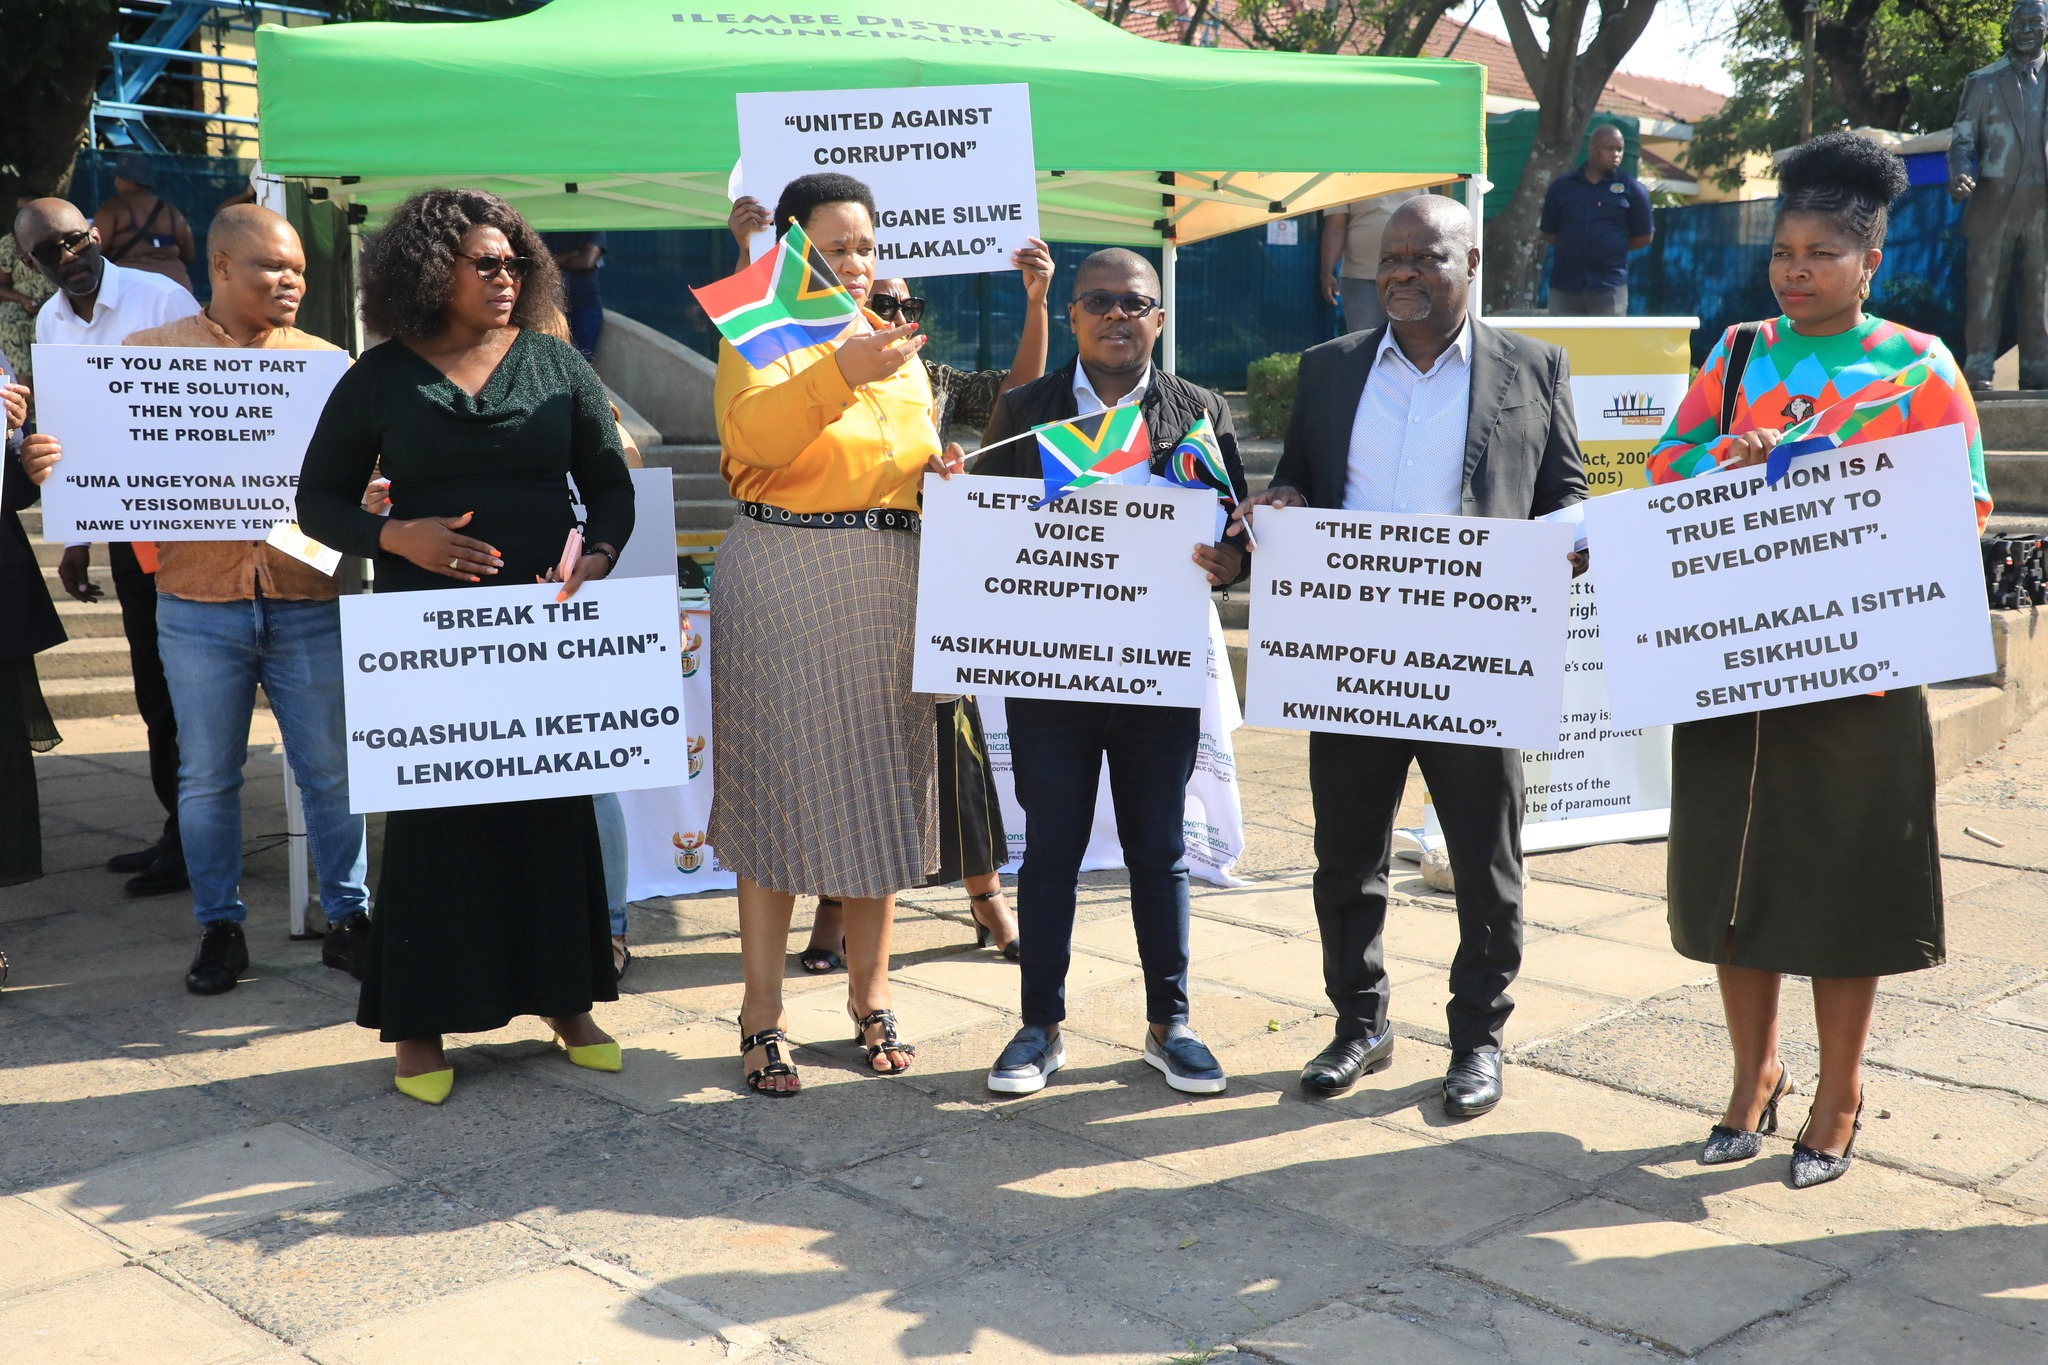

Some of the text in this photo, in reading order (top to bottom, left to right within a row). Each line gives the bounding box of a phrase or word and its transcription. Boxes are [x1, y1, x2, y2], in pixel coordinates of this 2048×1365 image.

[672, 13, 1056, 42] ILEMBE DISTRICT
[726, 28, 1022, 48] MUNICIPALITY
[785, 108, 992, 132] “UNITED AGAINST
[814, 141, 976, 165] CORRUPTION”
[953, 203, 1022, 224] SILWE
[875, 237, 1002, 260] HLAKALO”.
[87, 357, 306, 372] “IF YOU ARE NOT PART
[109, 381, 289, 398] OF THE SOLUTION,
[129, 405, 272, 418] THEN YOU ARE
[129, 429, 275, 441] THE PROBLEM”
[1582, 454, 1610, 468] Act,
[1840, 458, 1866, 478] IS
[1875, 452, 1894, 472] A
[67, 476, 120, 487] “UMA
[127, 476, 235, 487] UNGEYONA
[1588, 471, 1622, 486] 005)
[121, 498, 289, 512] YESISOMBULULO,
[968, 492, 1175, 520] “LET’S RAISE OUR
[1667, 489, 1882, 545] TRUE ENEMY TO
[76, 520, 124, 530] NAWE
[130, 520, 236, 530] UYINGXENYE
[1035, 523, 1104, 542] VOICE
[1316, 522, 1489, 545] “THE PRICE OF
[1016, 549, 1119, 569] AGAINST
[1672, 524, 1887, 578] DEVELOPMENT”.
[1327, 553, 1481, 577] CORRUPTION
[985, 577, 1147, 602] CORRUPTION”
[1272, 580, 1536, 613] IS PAID BY THE POOR”.
[424, 601, 599, 629] “BREAK THE
[1656, 600, 1843, 648] INKOHLAKALA
[1852, 582, 1946, 614] ISITHA
[359, 633, 666, 673] CORRUPTION CHAIN”.
[932, 636, 1191, 667] “ASIKHULUMELI SILWE
[1261, 640, 1534, 676] “ABAMPOFU ABAZWELA
[1724, 632, 1858, 670] ESIKHULU
[957, 667, 1161, 695] NENKOHLAKALO”.
[1337, 677, 1450, 701] KAKHULU
[1696, 661, 1898, 708] SENTUTHUKO”.
[352, 706, 679, 749] “GQASHULA IKETANGO
[1283, 702, 1501, 736] KWINKOHLAKALO”.
[1572, 712, 1596, 724] may
[1574, 728, 1596, 740] and
[398, 746, 649, 785] LENKOHLAKALO”.
[1576, 778, 1588, 790] of
[1592, 778, 1610, 790] the
[1533, 802, 1548, 813] be
[1551, 799, 1563, 811] of
[1566, 795, 1631, 812] paramount
